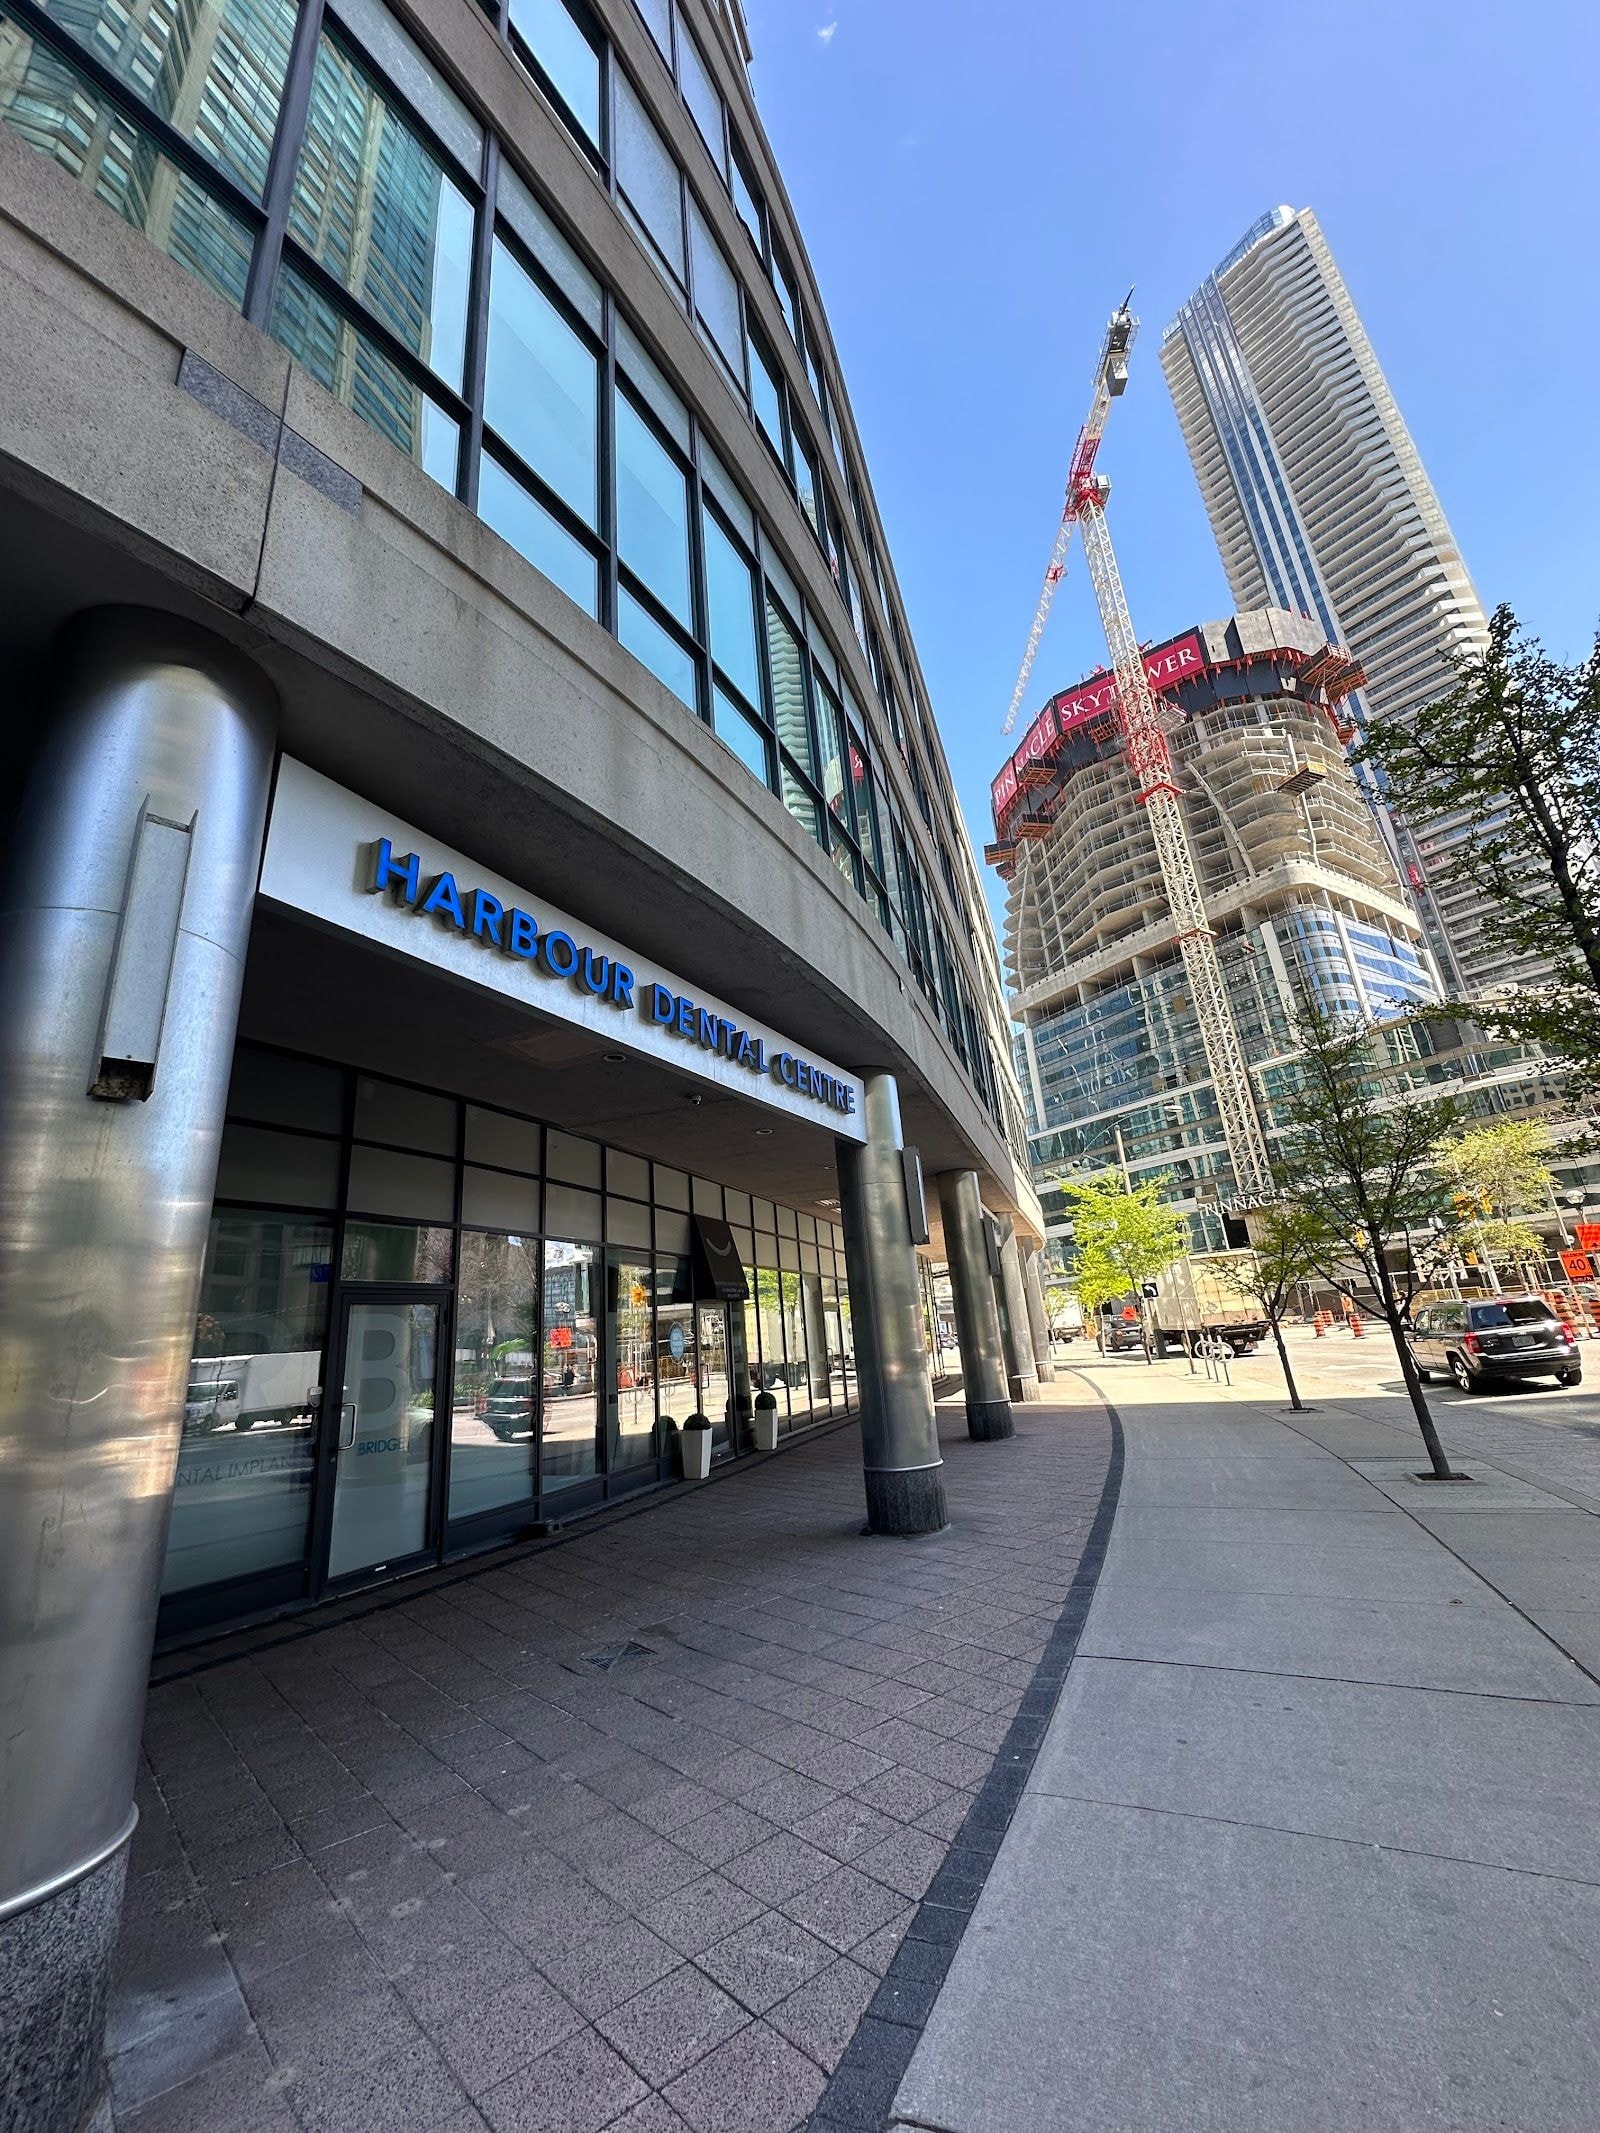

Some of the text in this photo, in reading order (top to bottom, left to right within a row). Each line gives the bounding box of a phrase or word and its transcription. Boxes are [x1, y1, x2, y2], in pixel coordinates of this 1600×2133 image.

[1061, 647, 1199, 722] SKYTWER
[368, 837, 856, 1115] HARBOUR DENTAL CENTRE
[1569, 1258, 1586, 1271] 40
[177, 1455, 292, 1488] NTAL IMPLAN
